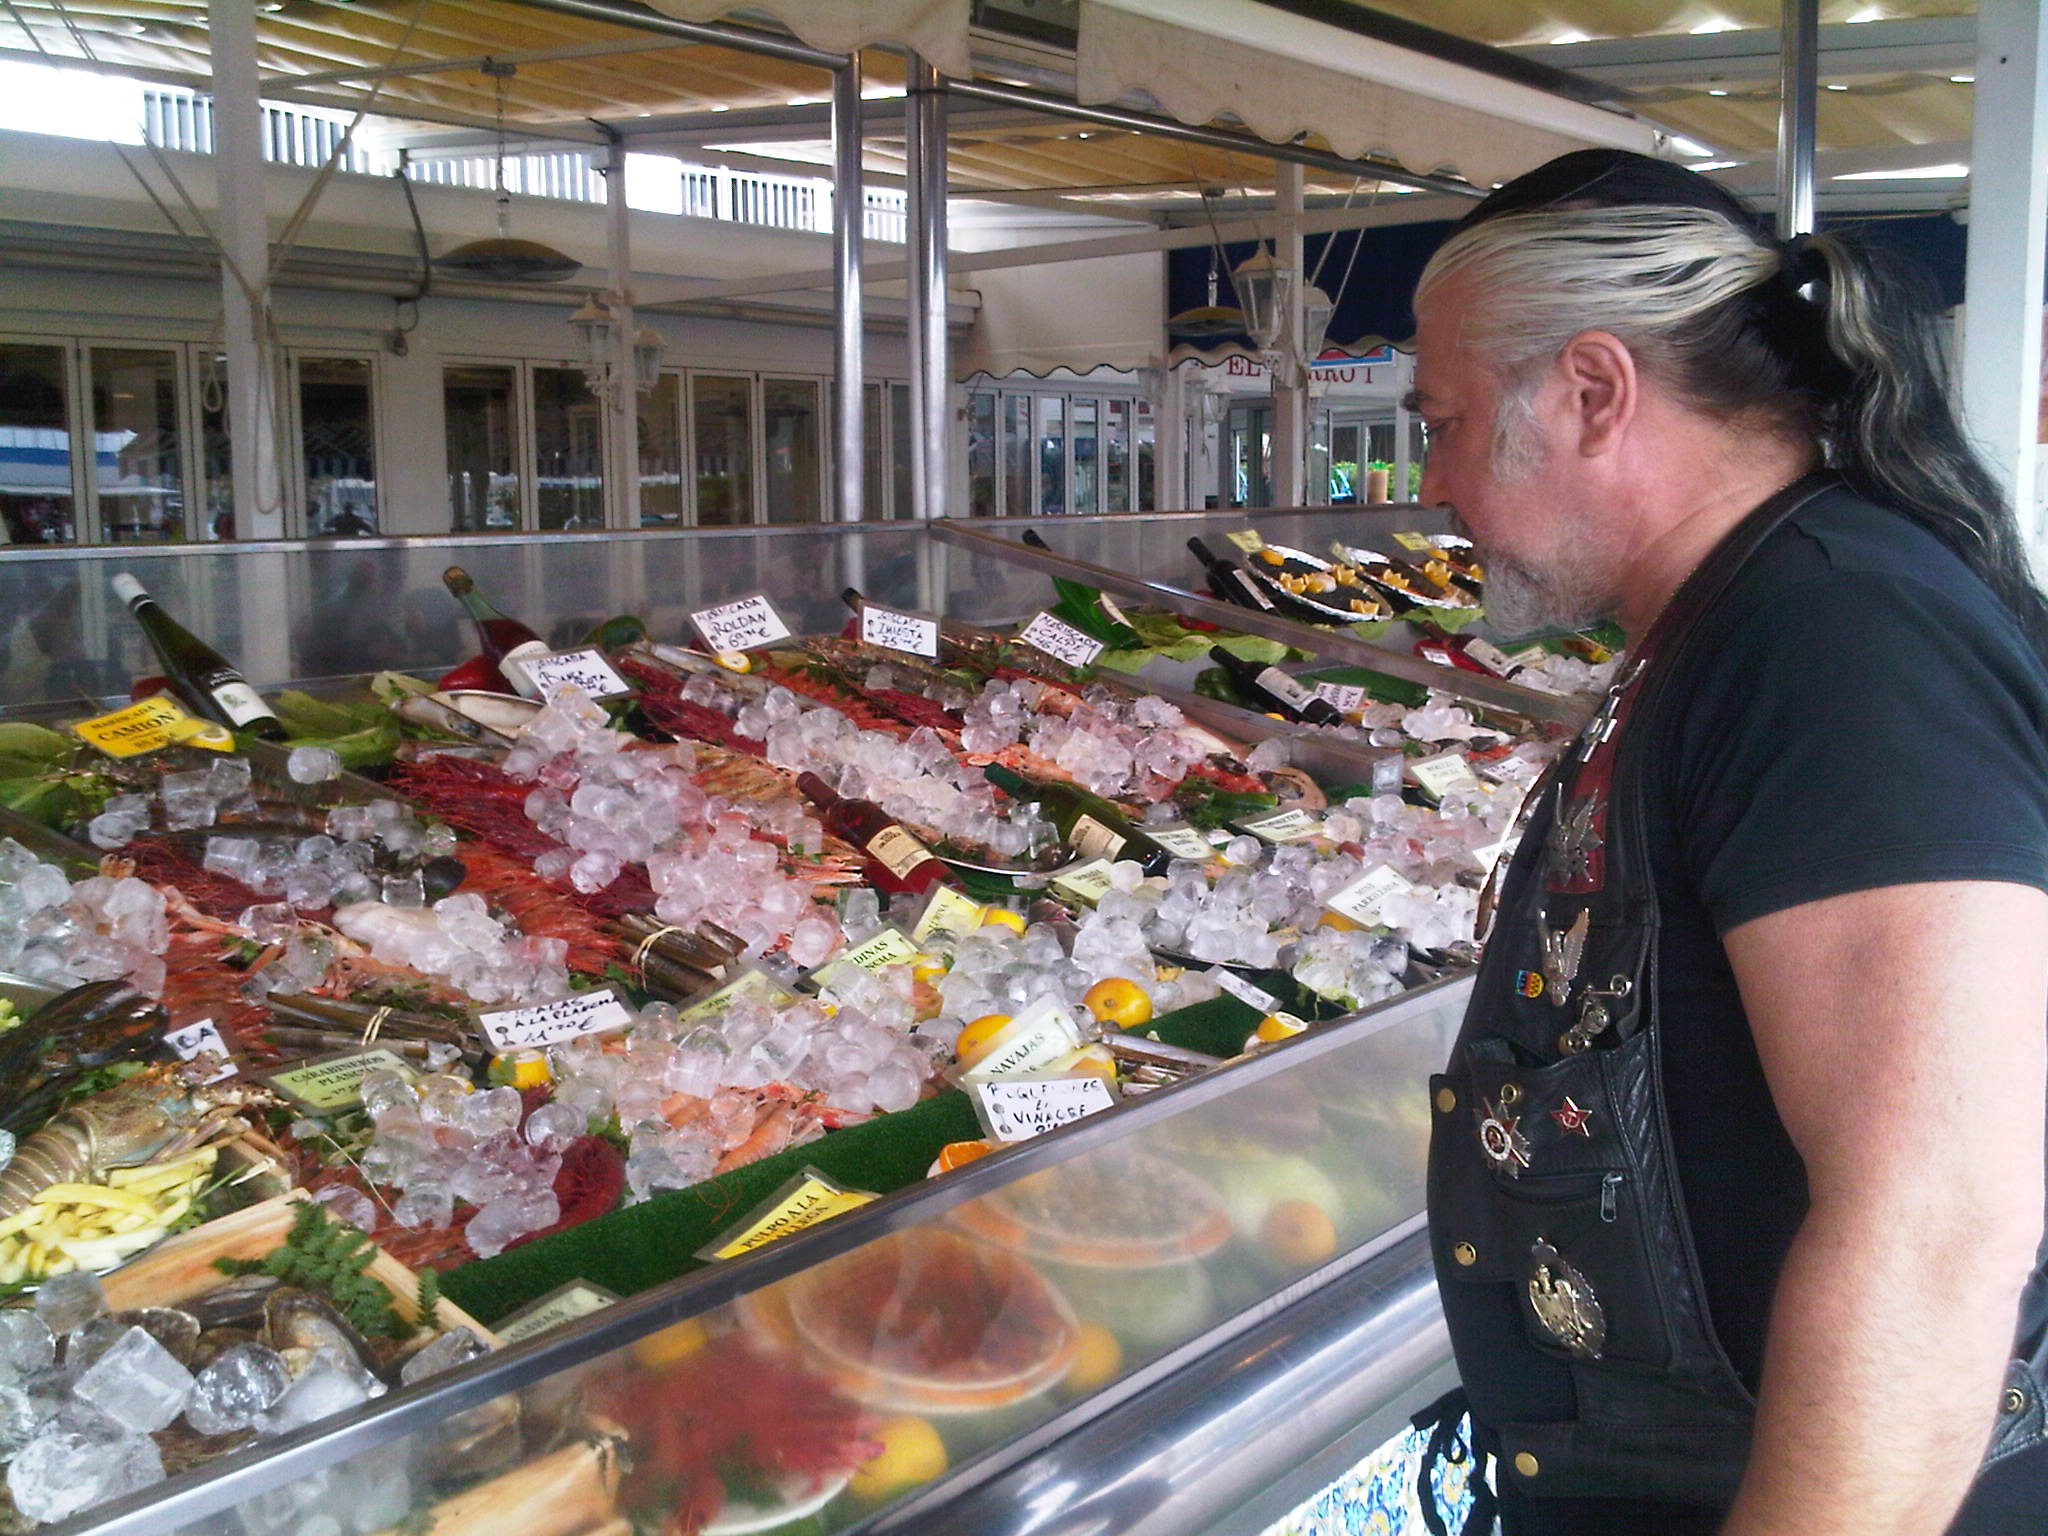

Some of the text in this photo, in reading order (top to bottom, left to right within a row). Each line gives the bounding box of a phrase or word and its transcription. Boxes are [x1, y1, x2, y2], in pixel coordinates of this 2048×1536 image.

[1227, 356, 1261, 376] EL
[711, 612, 766, 637] ROLDAN
[1039, 628, 1083, 651] CALPE
[529, 1013, 549, 1025] LA
[991, 1032, 1044, 1074] NAVAJAS
